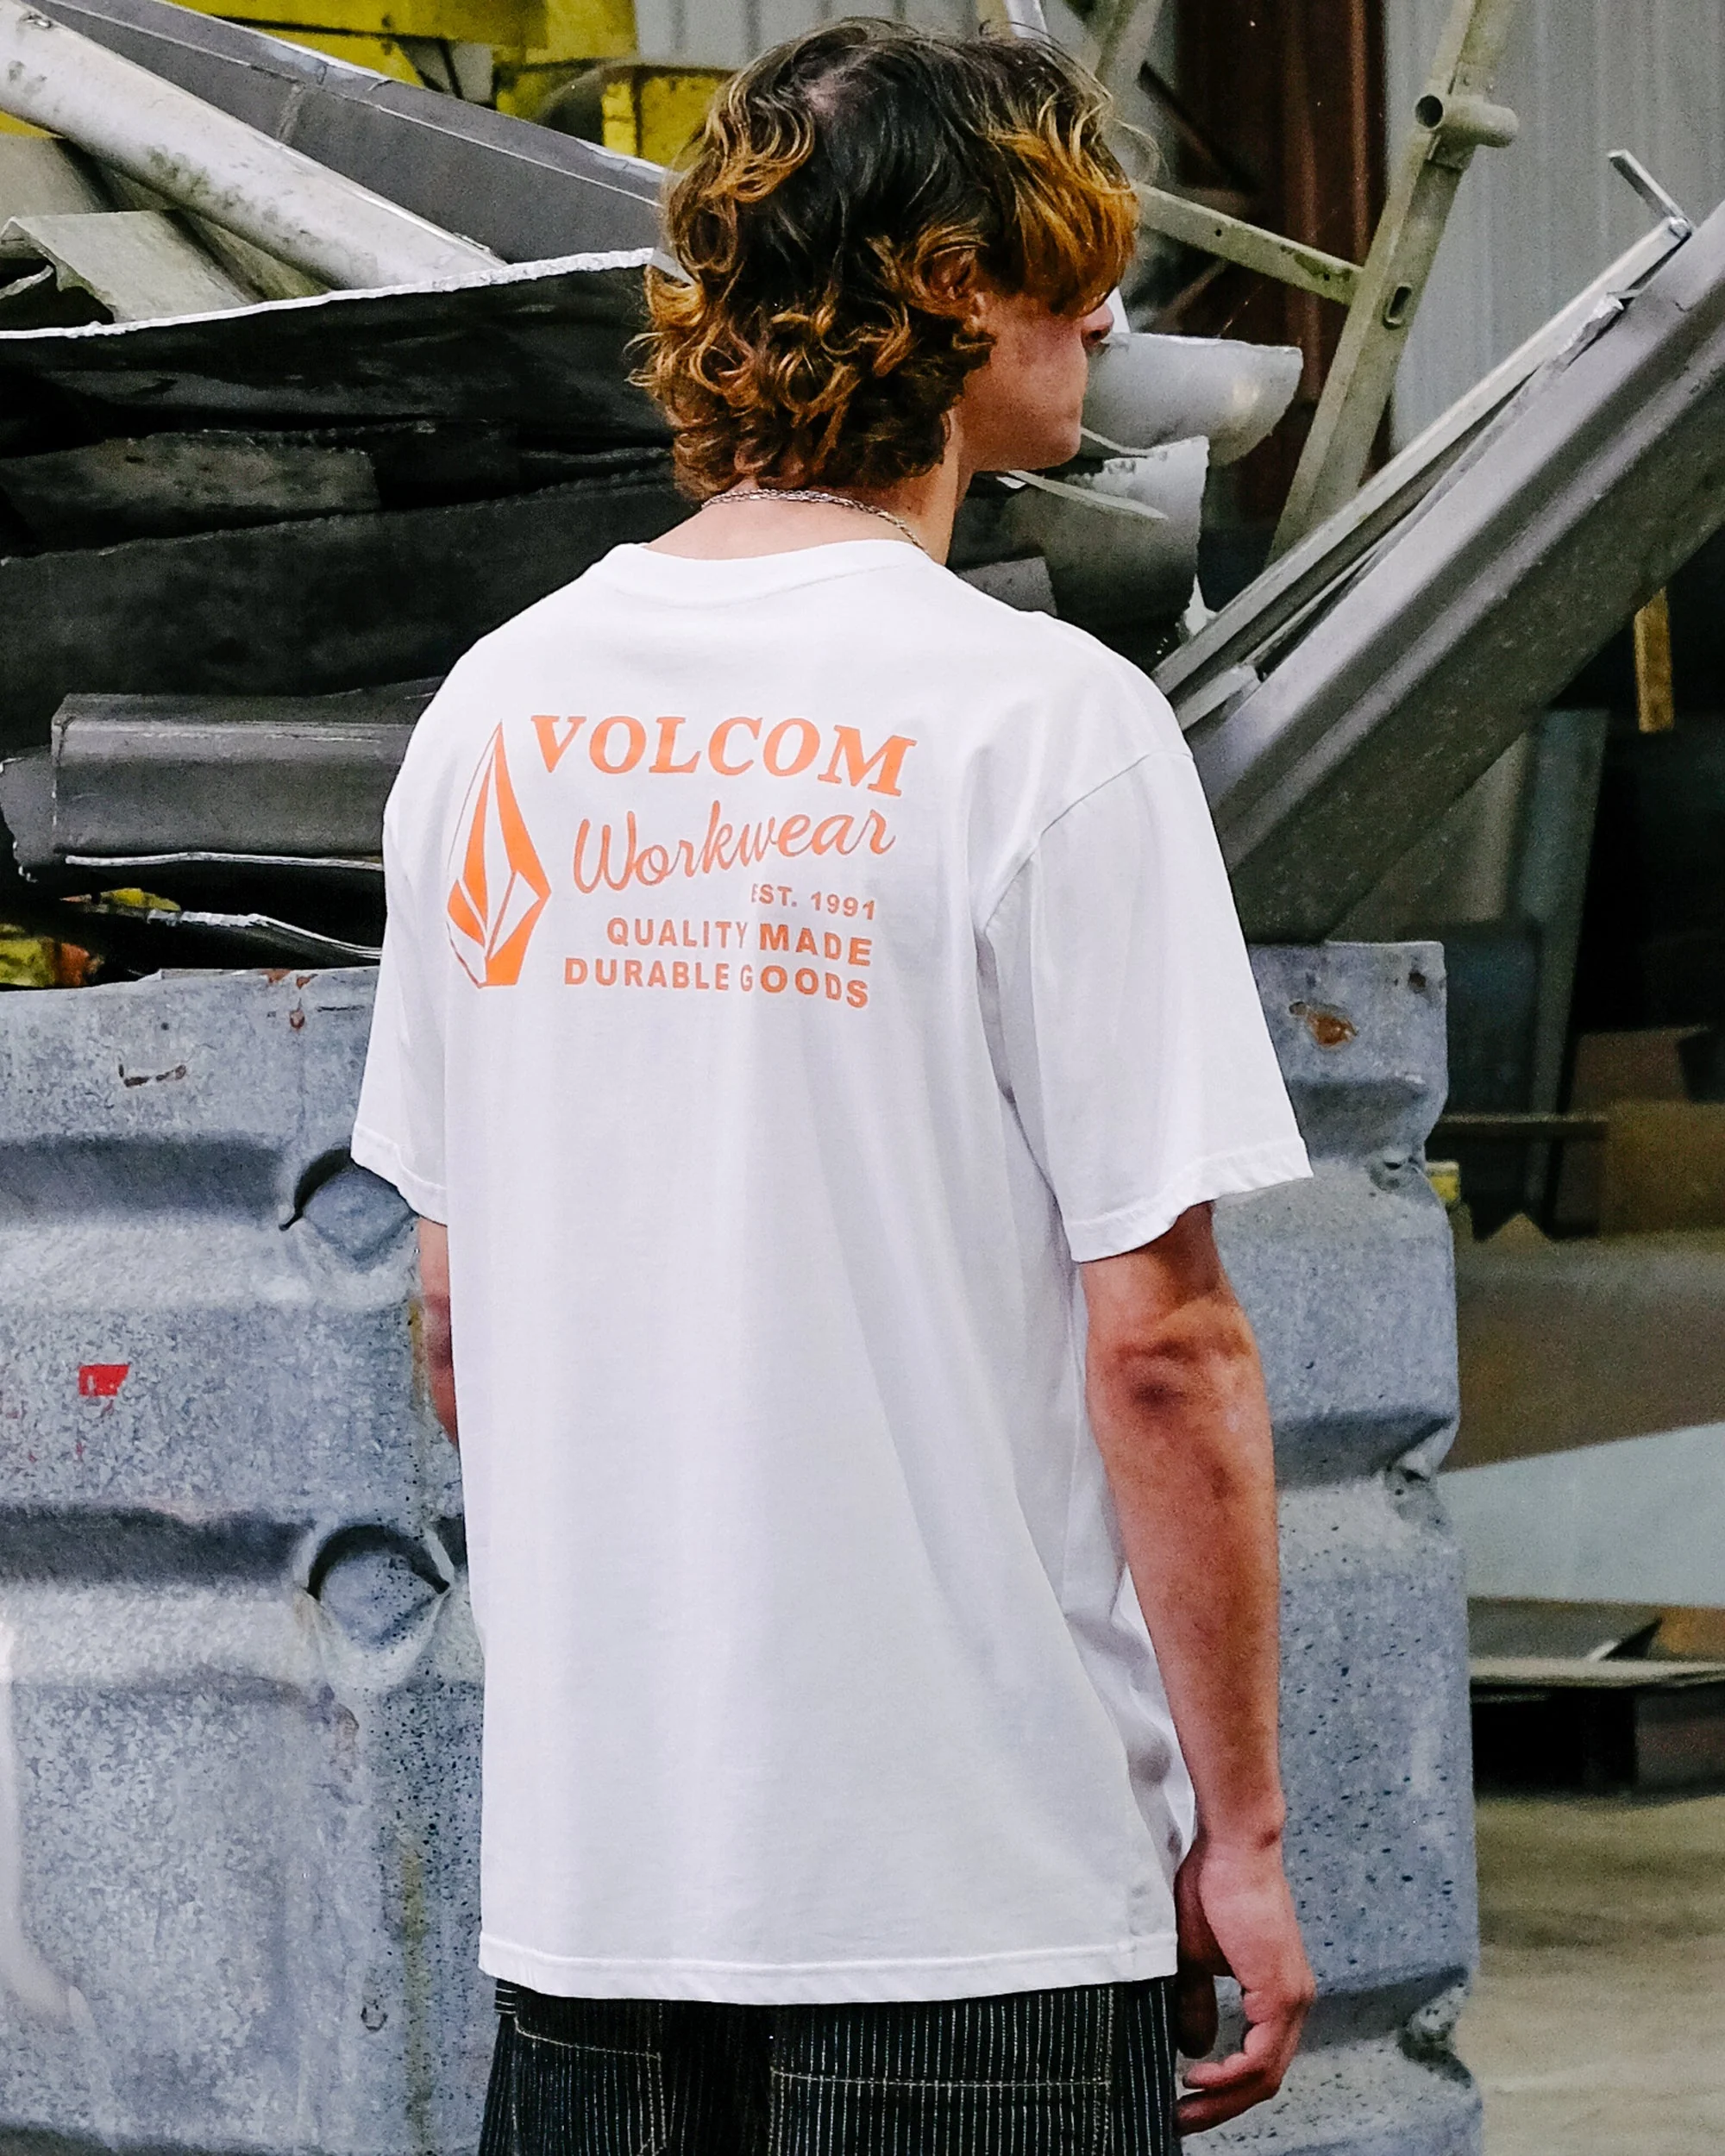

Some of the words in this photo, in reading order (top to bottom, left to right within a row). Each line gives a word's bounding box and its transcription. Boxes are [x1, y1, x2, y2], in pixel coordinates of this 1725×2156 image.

[530, 715, 918, 797] VOLCOM
[572, 799, 897, 894] Workwear
[812, 891, 876, 920] 1991
[606, 917, 748, 949] QUALITY
[759, 923, 873, 967] MADE
[563, 957, 731, 991] DURABLE
[739, 964, 869, 1008] GOODS
